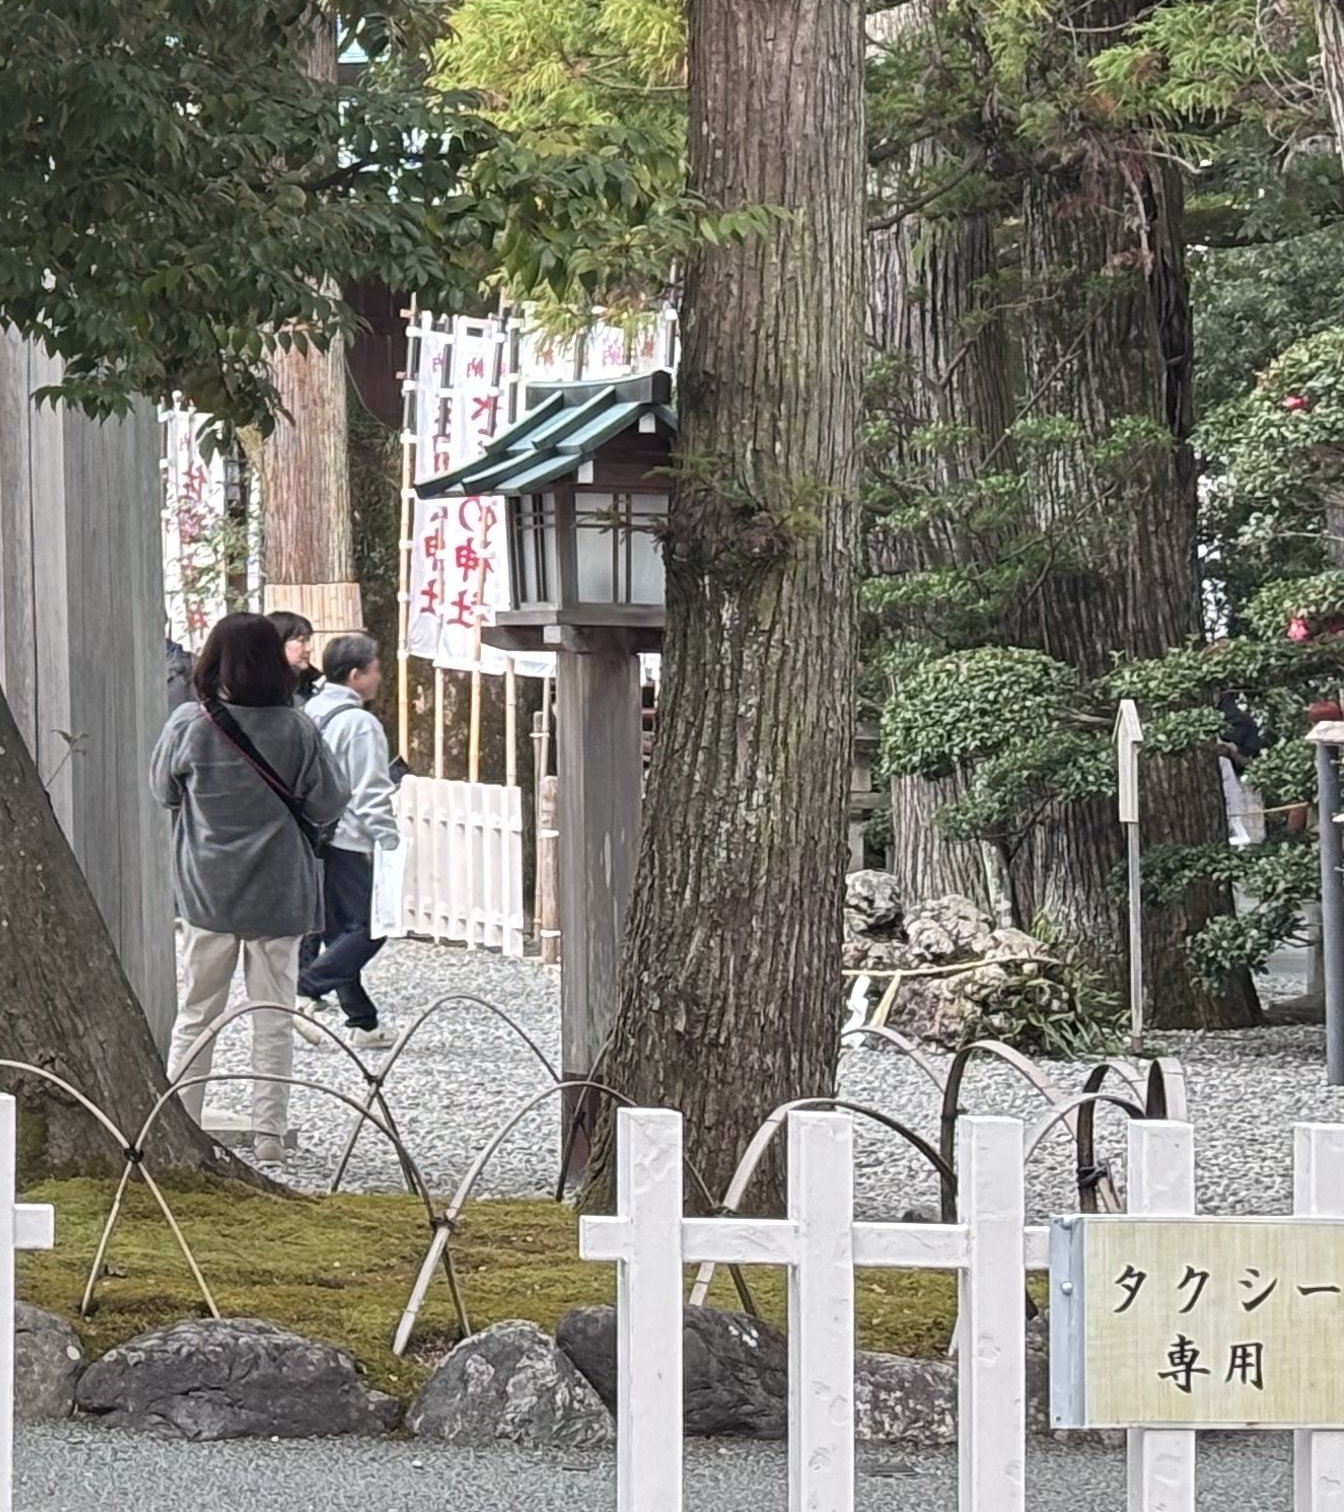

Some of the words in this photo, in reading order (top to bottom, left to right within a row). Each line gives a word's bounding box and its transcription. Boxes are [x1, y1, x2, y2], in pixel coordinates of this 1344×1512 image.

[1113, 1264, 1342, 1314] タクシー
[1157, 1334, 1264, 1394] 専用
